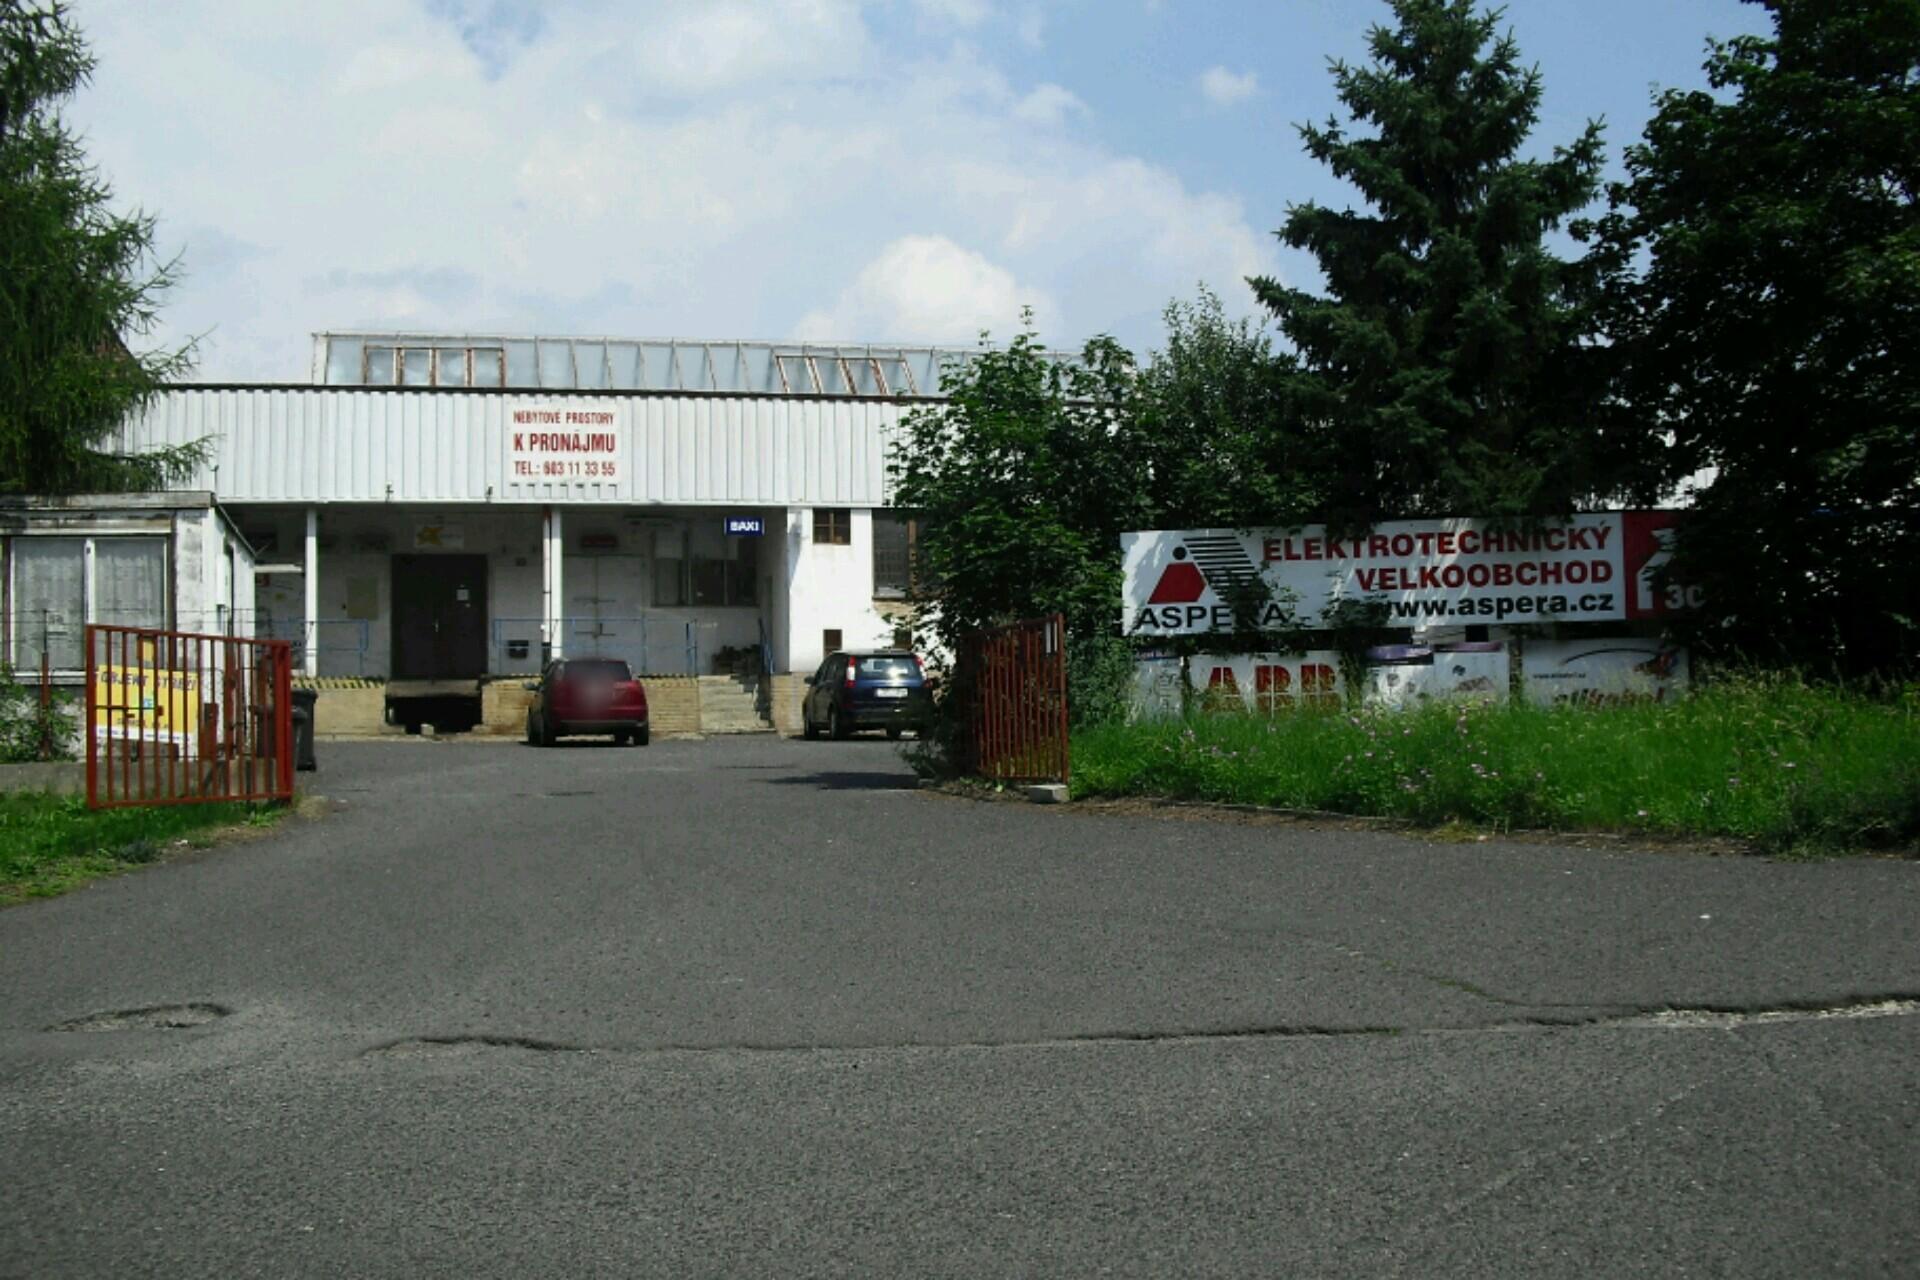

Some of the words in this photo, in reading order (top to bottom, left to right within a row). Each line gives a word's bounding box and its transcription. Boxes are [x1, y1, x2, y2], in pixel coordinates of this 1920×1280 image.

[513, 432, 523, 451] K
[529, 428, 615, 453] PRONÁJMU
[568, 462, 579, 475] 11
[730, 521, 759, 531] BAXI
[1263, 519, 1612, 561] ELEKTROTECHNICKÝ
[1355, 560, 1613, 591] VELKOOBCHOD
[1134, 603, 1288, 629] ASPEA
[1368, 593, 1614, 620] ww.aspera.cz
